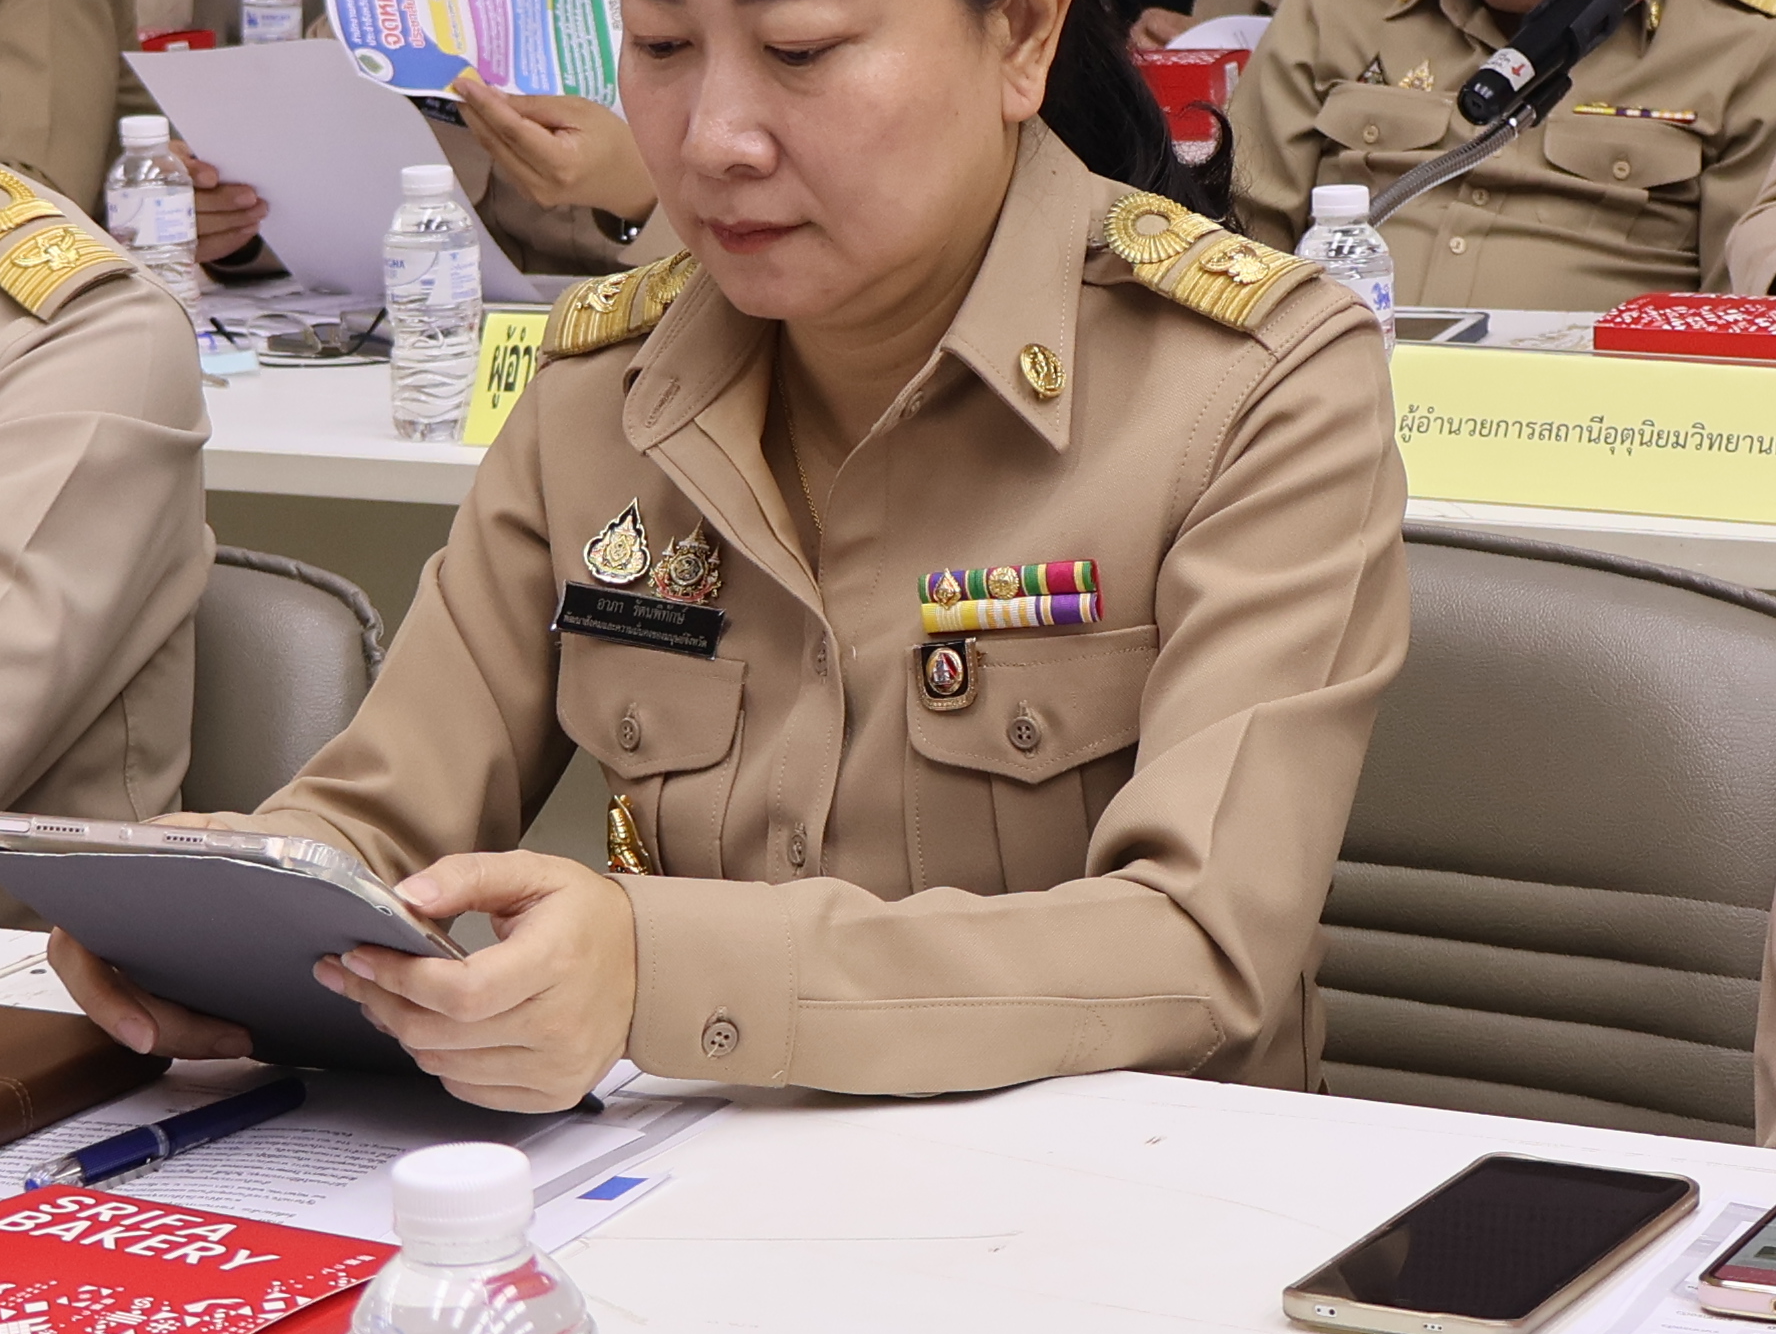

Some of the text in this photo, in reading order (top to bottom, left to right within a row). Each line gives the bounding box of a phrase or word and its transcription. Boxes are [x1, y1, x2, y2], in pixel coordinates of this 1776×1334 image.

[596, 597, 688, 625] อาภา รัตนพิทักษ์
[40, 1195, 237, 1242] SRIFA
